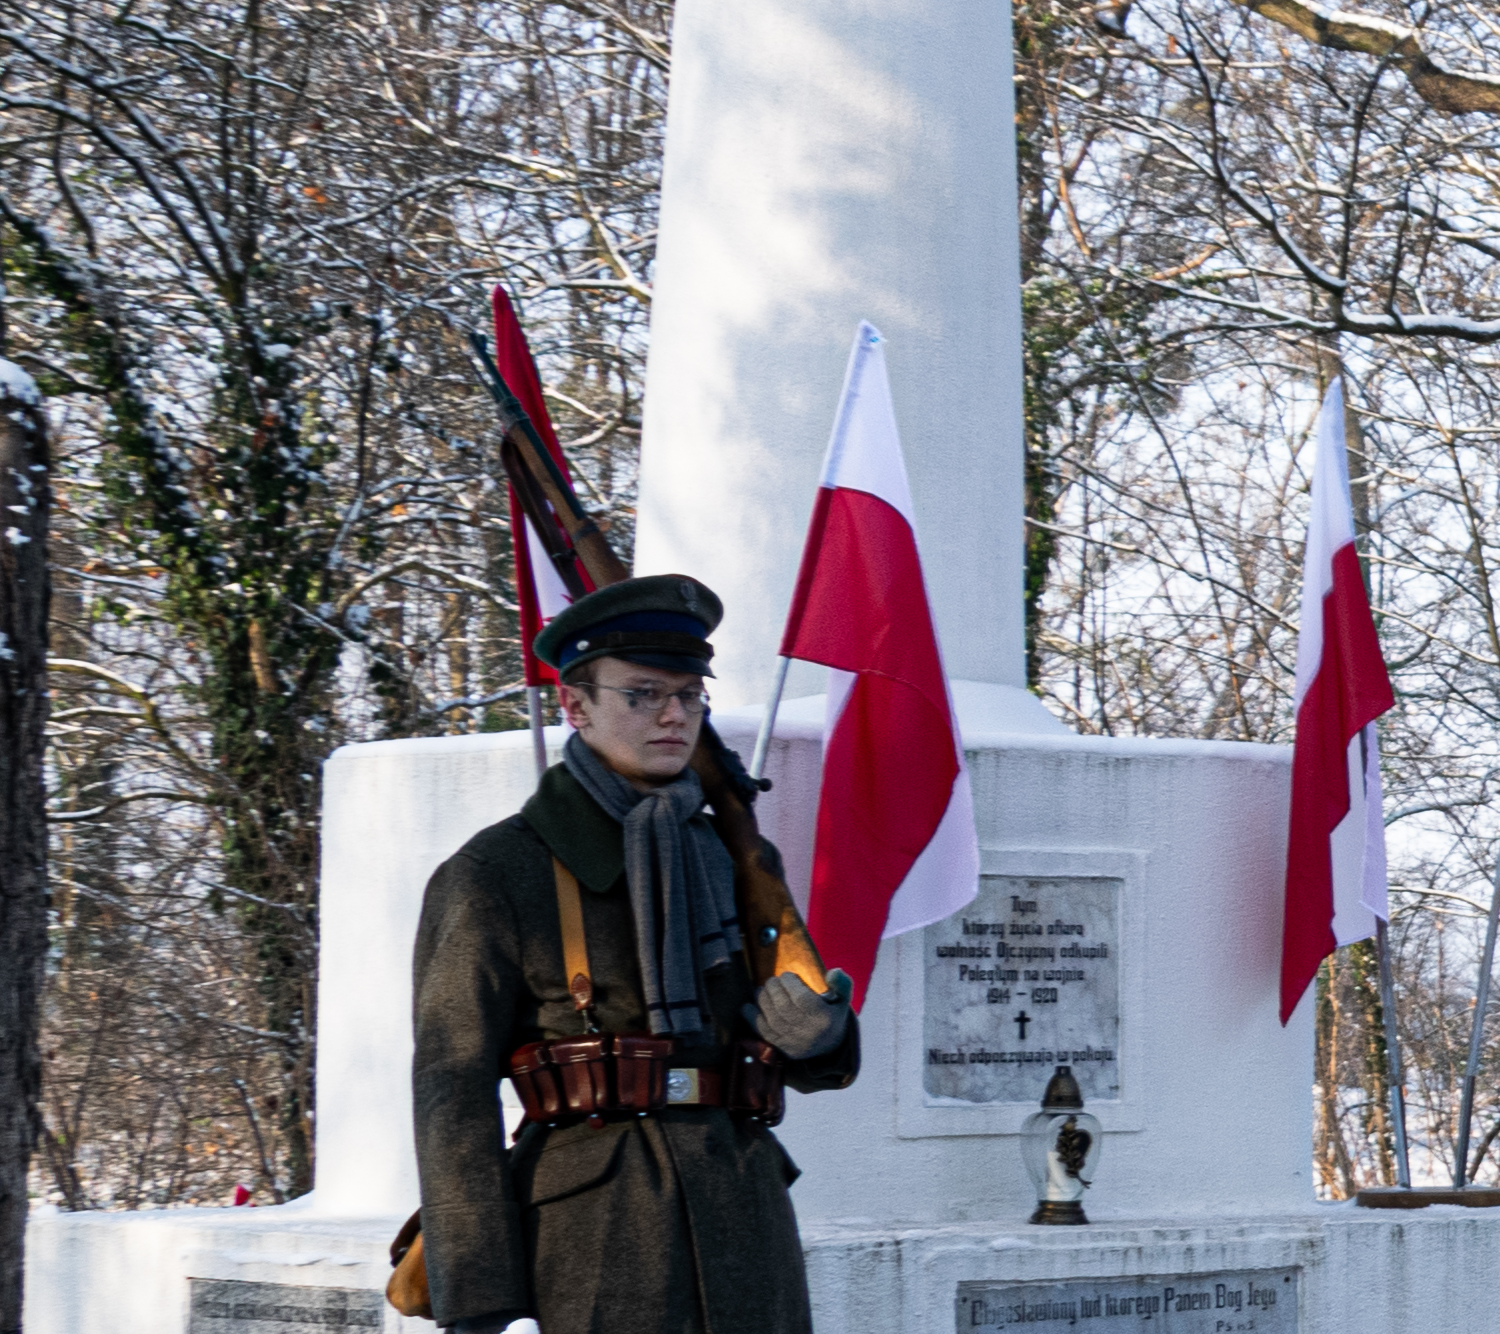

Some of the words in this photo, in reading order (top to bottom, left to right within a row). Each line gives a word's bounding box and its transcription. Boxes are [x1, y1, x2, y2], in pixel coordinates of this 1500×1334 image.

[1010, 895, 1038, 916] Tym
[1009, 919, 1043, 938] życia
[996, 941, 1055, 963] Ojczyzny
[1059, 942, 1108, 961] odkupili
[1024, 969, 1039, 981] na
[1043, 967, 1084, 985] wojnie
[986, 987, 1011, 1004] 1914
[1031, 987, 1058, 1004] 1920
[928, 1047, 965, 1065] Niech
[1057, 1050, 1069, 1062] w
[1164, 1287, 1211, 1313] Panem
